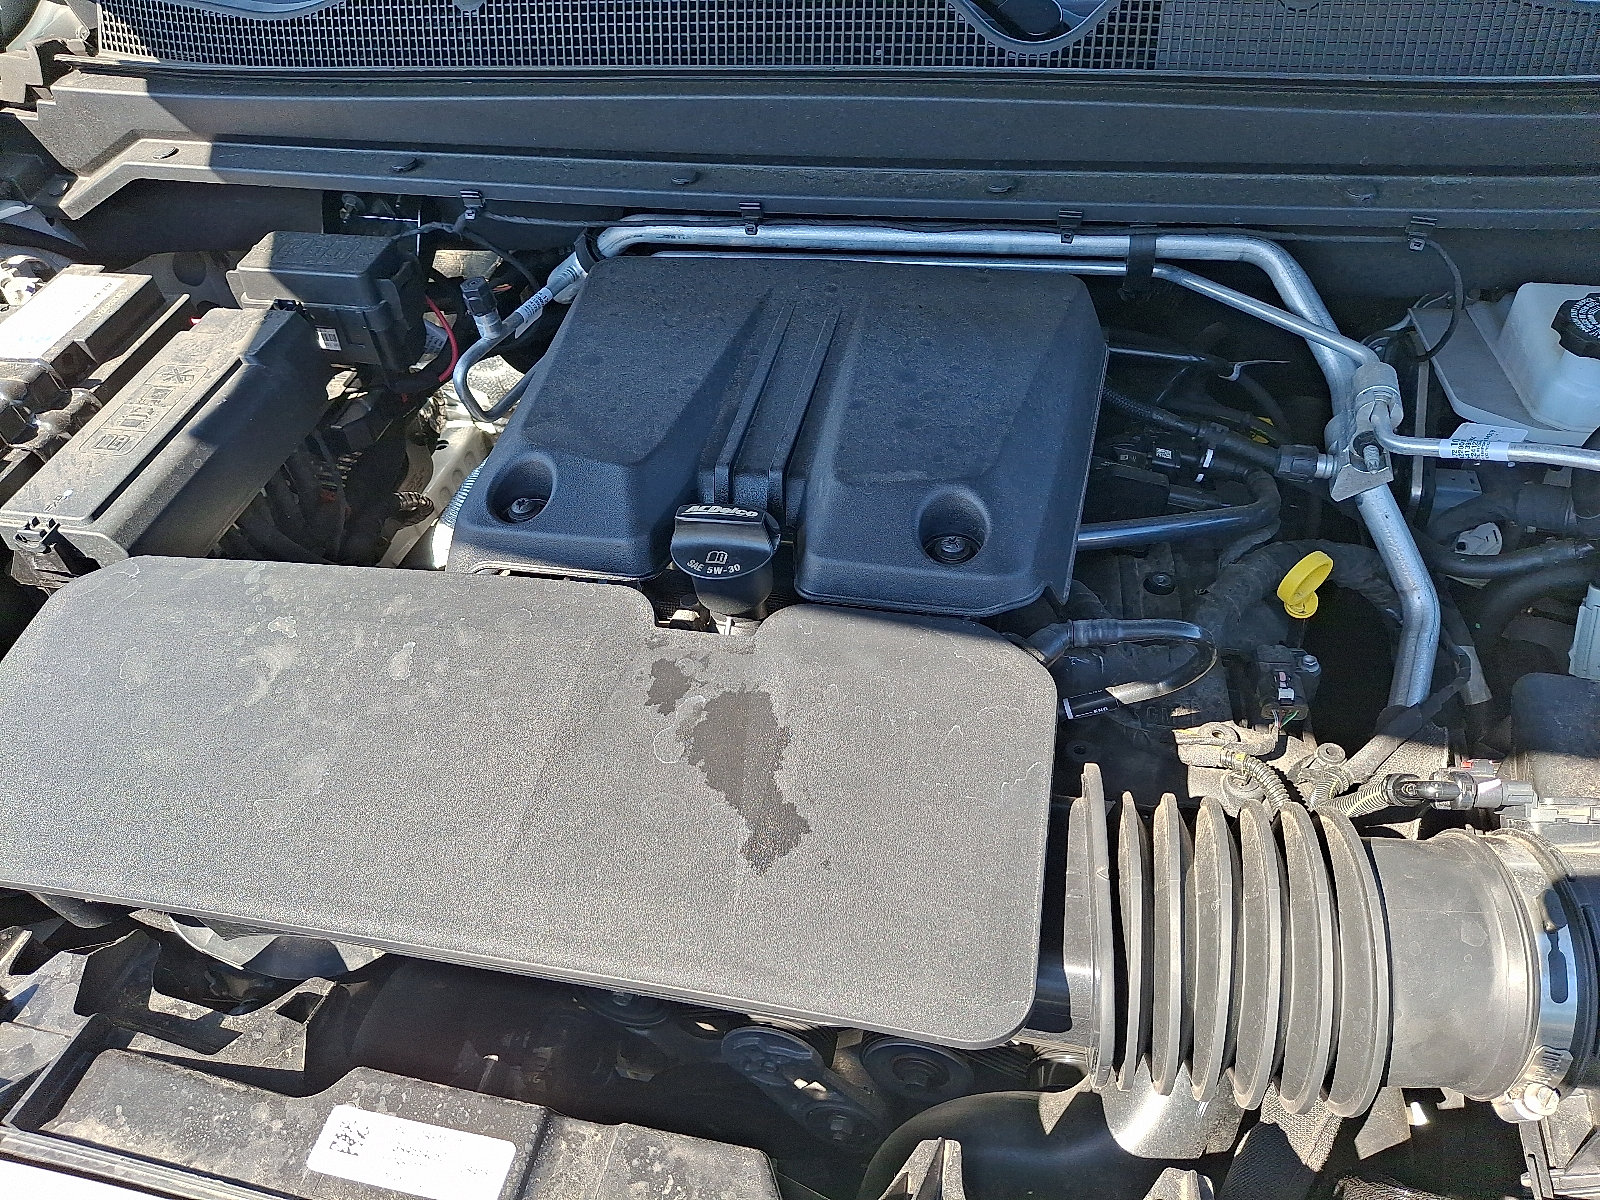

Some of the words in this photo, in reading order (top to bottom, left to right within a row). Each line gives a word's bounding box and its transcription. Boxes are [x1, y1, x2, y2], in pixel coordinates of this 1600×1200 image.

[685, 505, 759, 517] ACDelco
[687, 560, 705, 572] SAE
[706, 563, 741, 575] 5W-30
